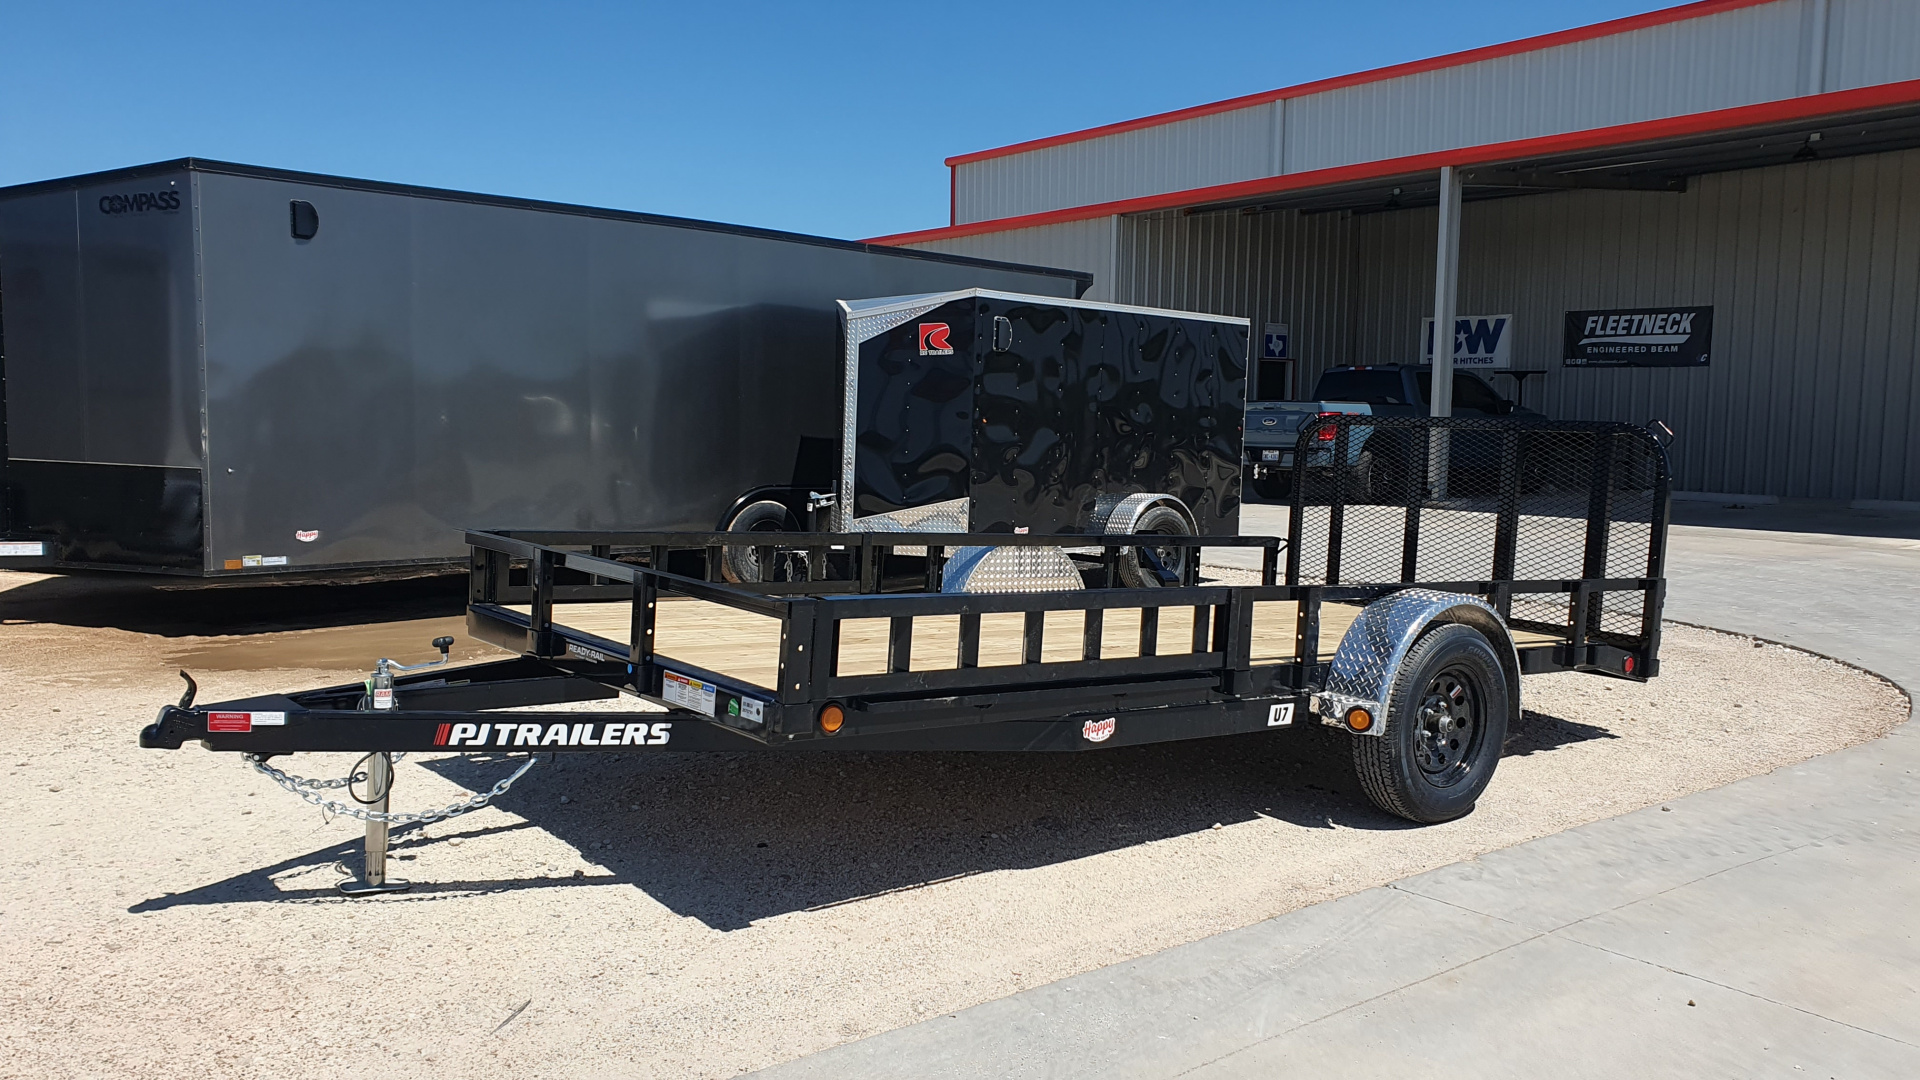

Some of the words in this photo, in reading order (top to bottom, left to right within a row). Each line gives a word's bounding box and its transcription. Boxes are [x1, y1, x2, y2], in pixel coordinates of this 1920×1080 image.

[99, 190, 181, 214] COMPASS
[1583, 312, 1697, 336] FLEETNECK
[1586, 345, 1647, 354] ENGINEERED
[1650, 345, 1679, 353] BEAM
[1460, 356, 1494, 365] HITCHES
[569, 643, 605, 662] READY-RAIL
[1273, 706, 1289, 722] U7
[448, 723, 491, 746] PJ
[494, 723, 672, 746] TRAILERS
[1084, 719, 1114, 738] Happy
